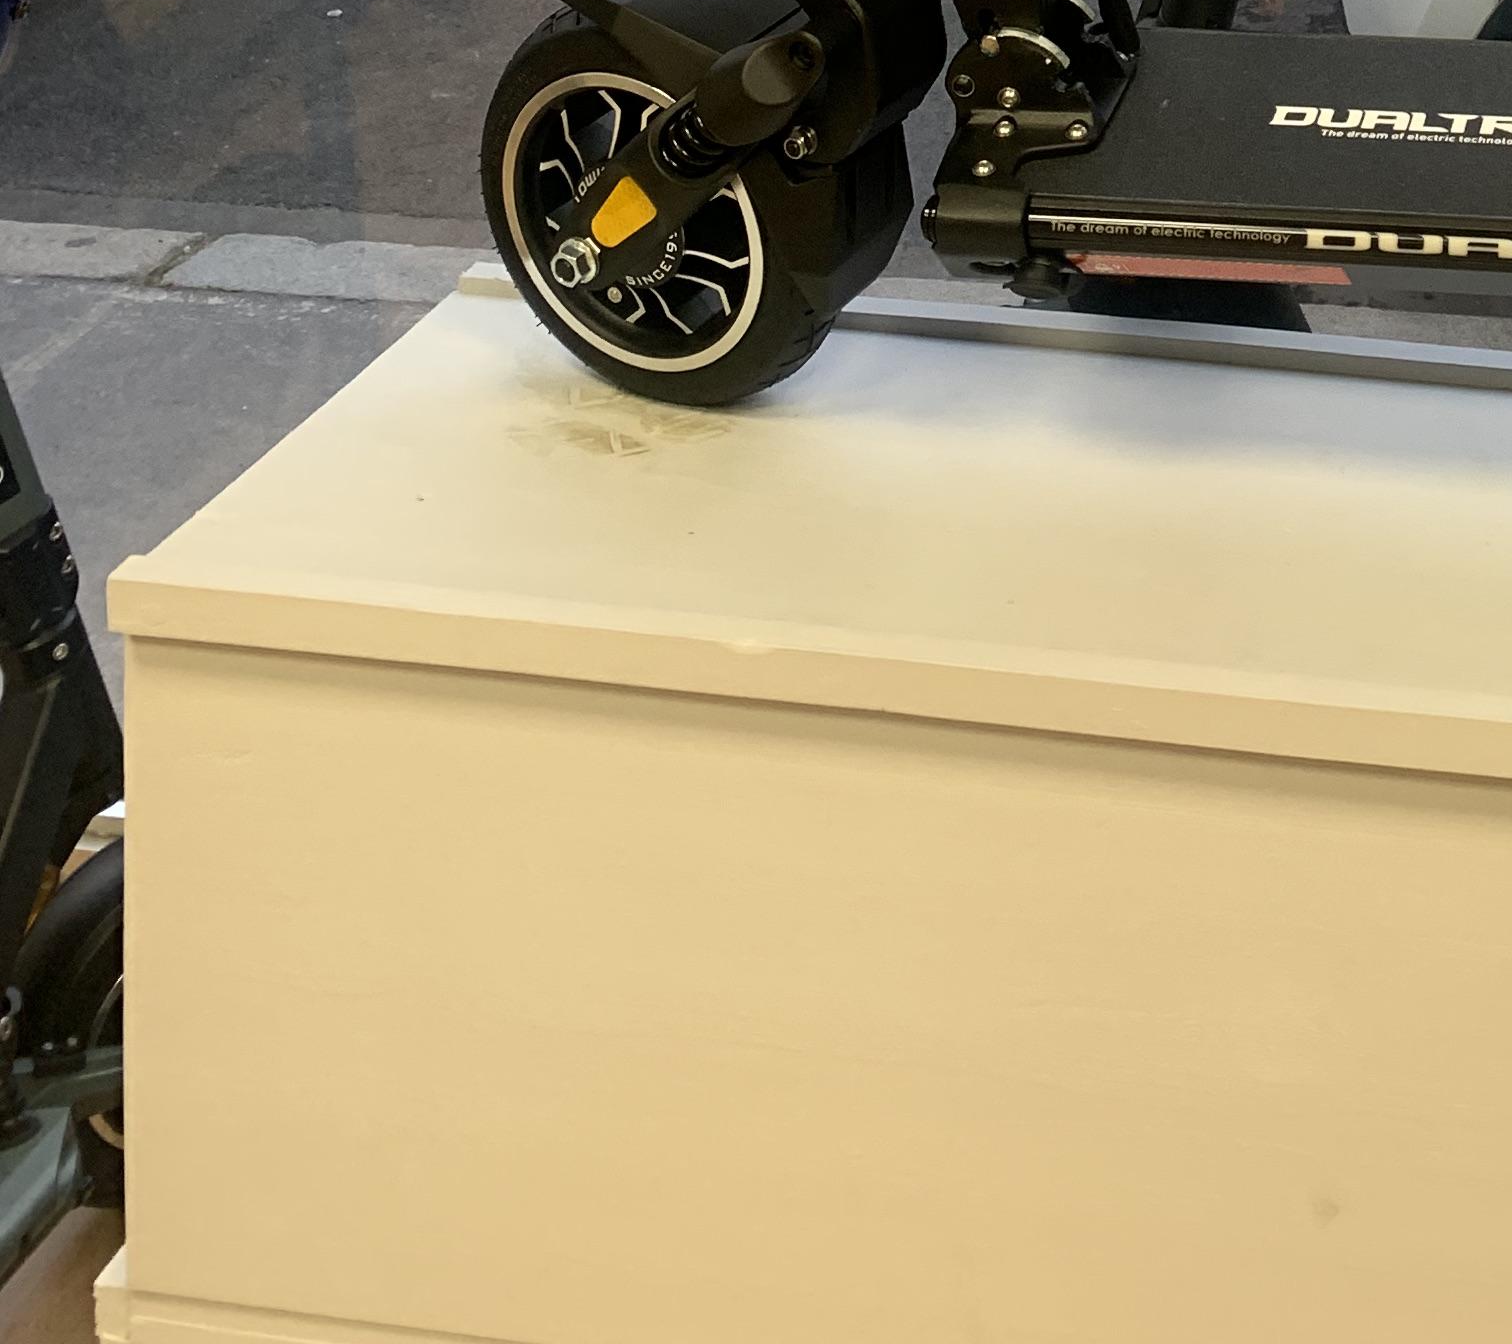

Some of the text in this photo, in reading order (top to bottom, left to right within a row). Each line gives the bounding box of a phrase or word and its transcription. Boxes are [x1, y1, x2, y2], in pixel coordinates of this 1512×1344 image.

[1320, 128, 1343, 138] The
[1346, 129, 1388, 141] dream
[1391, 131, 1405, 141] of
[1406, 132, 1456, 144] electric
[1050, 219, 1291, 245] The dream of electric technology
